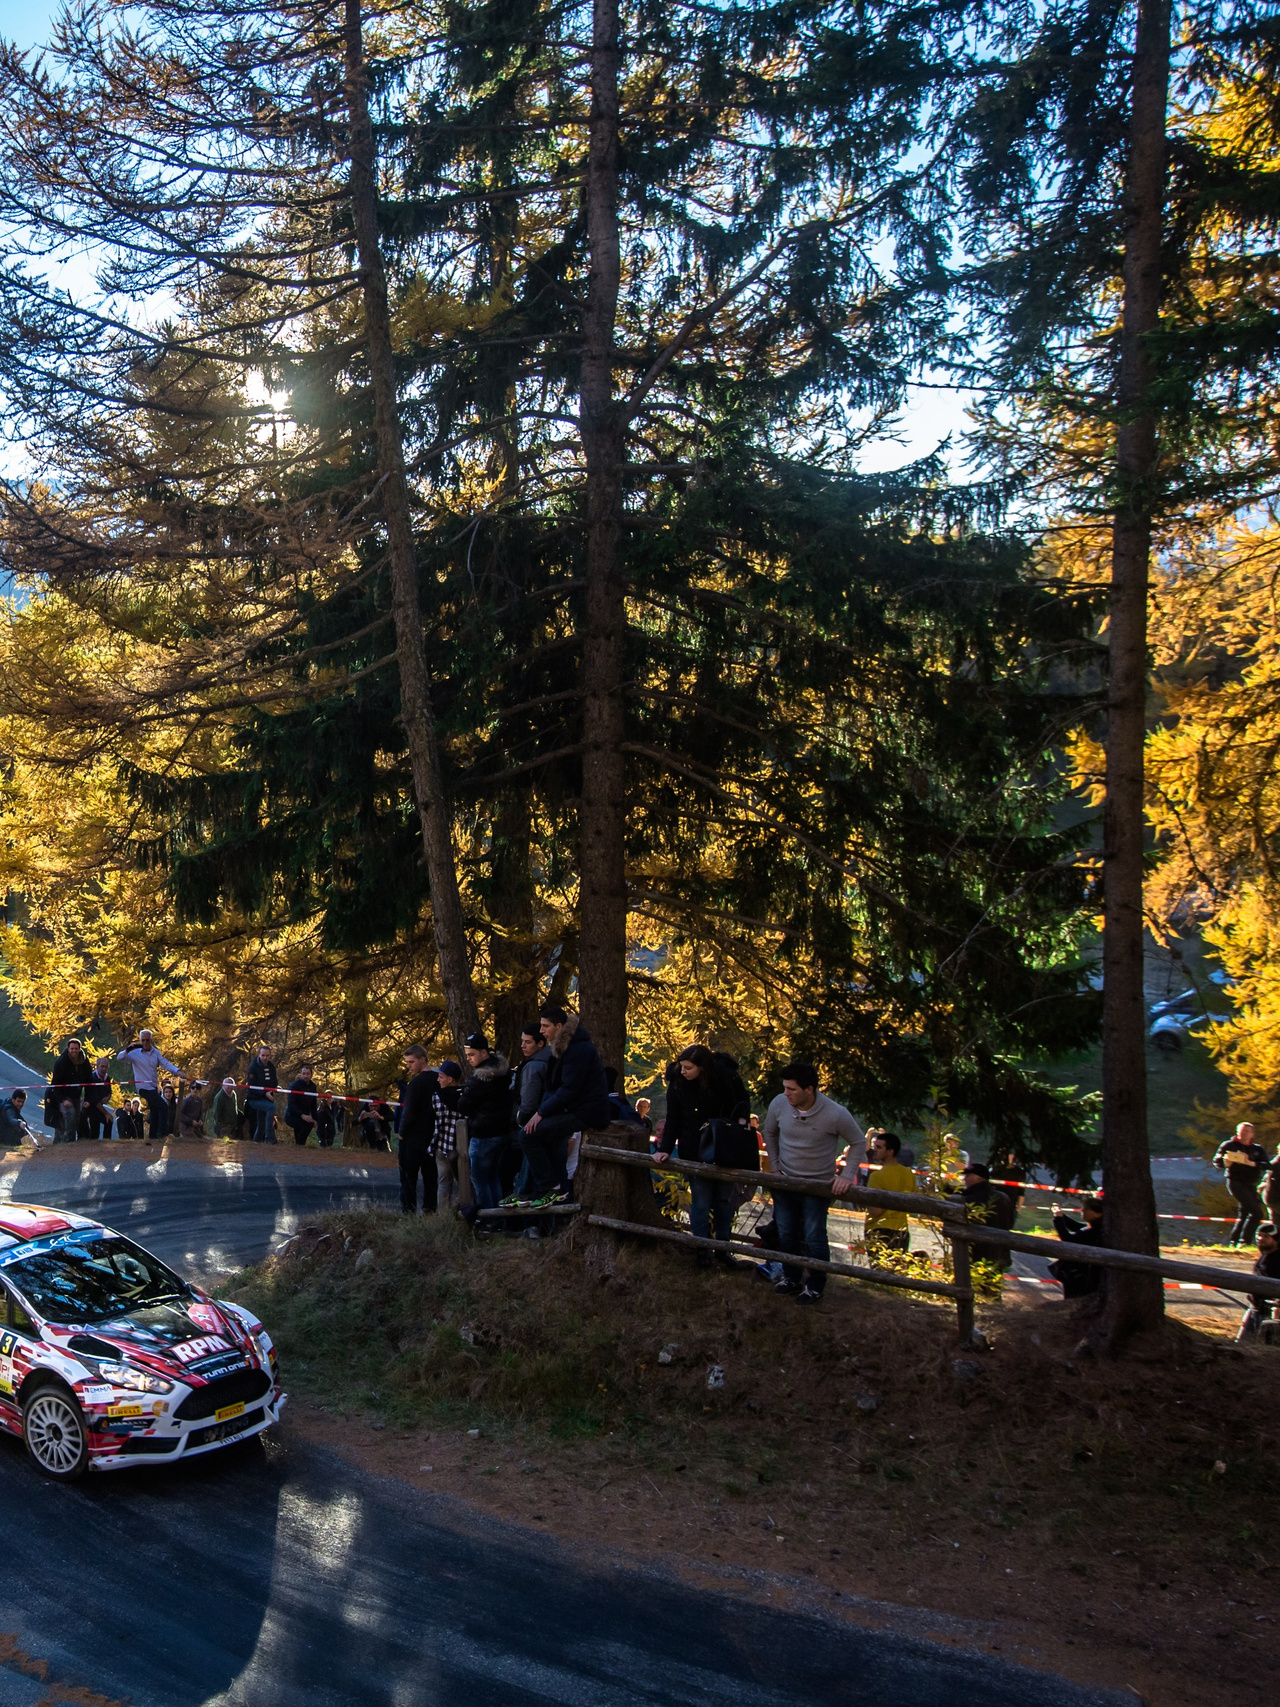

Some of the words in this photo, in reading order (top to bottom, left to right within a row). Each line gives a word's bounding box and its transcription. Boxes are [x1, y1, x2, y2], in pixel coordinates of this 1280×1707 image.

[2, 1335, 13, 1354] 3
[170, 1334, 234, 1363] RPM
[110, 1405, 140, 1416] PIRELLI
